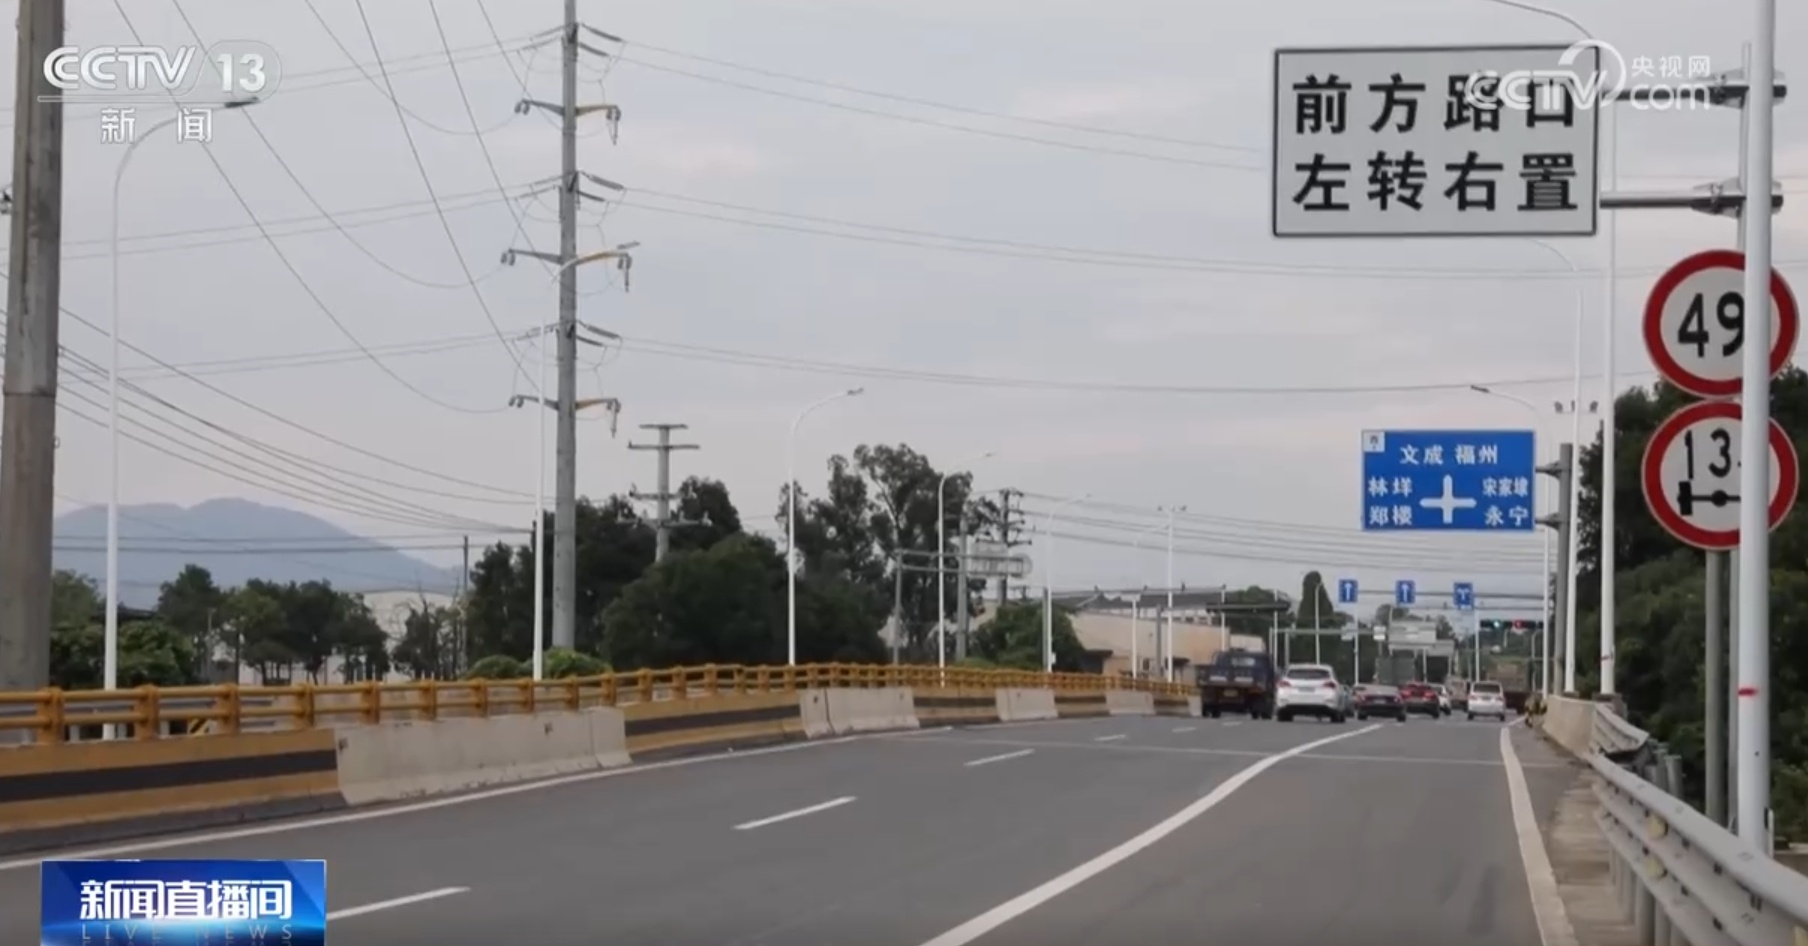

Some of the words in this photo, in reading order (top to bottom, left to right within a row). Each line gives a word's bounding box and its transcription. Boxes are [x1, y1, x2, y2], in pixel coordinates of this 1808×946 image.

[1293, 73, 1576, 134] 前方路口
[1294, 150, 1579, 212] 左转右置
[1678, 291, 1745, 358] 49
[1399, 444, 1444, 466] 文成
[1454, 444, 1499, 466] 福州
[1369, 505, 1413, 527] 郑楼
[1484, 505, 1529, 527] 永宁
